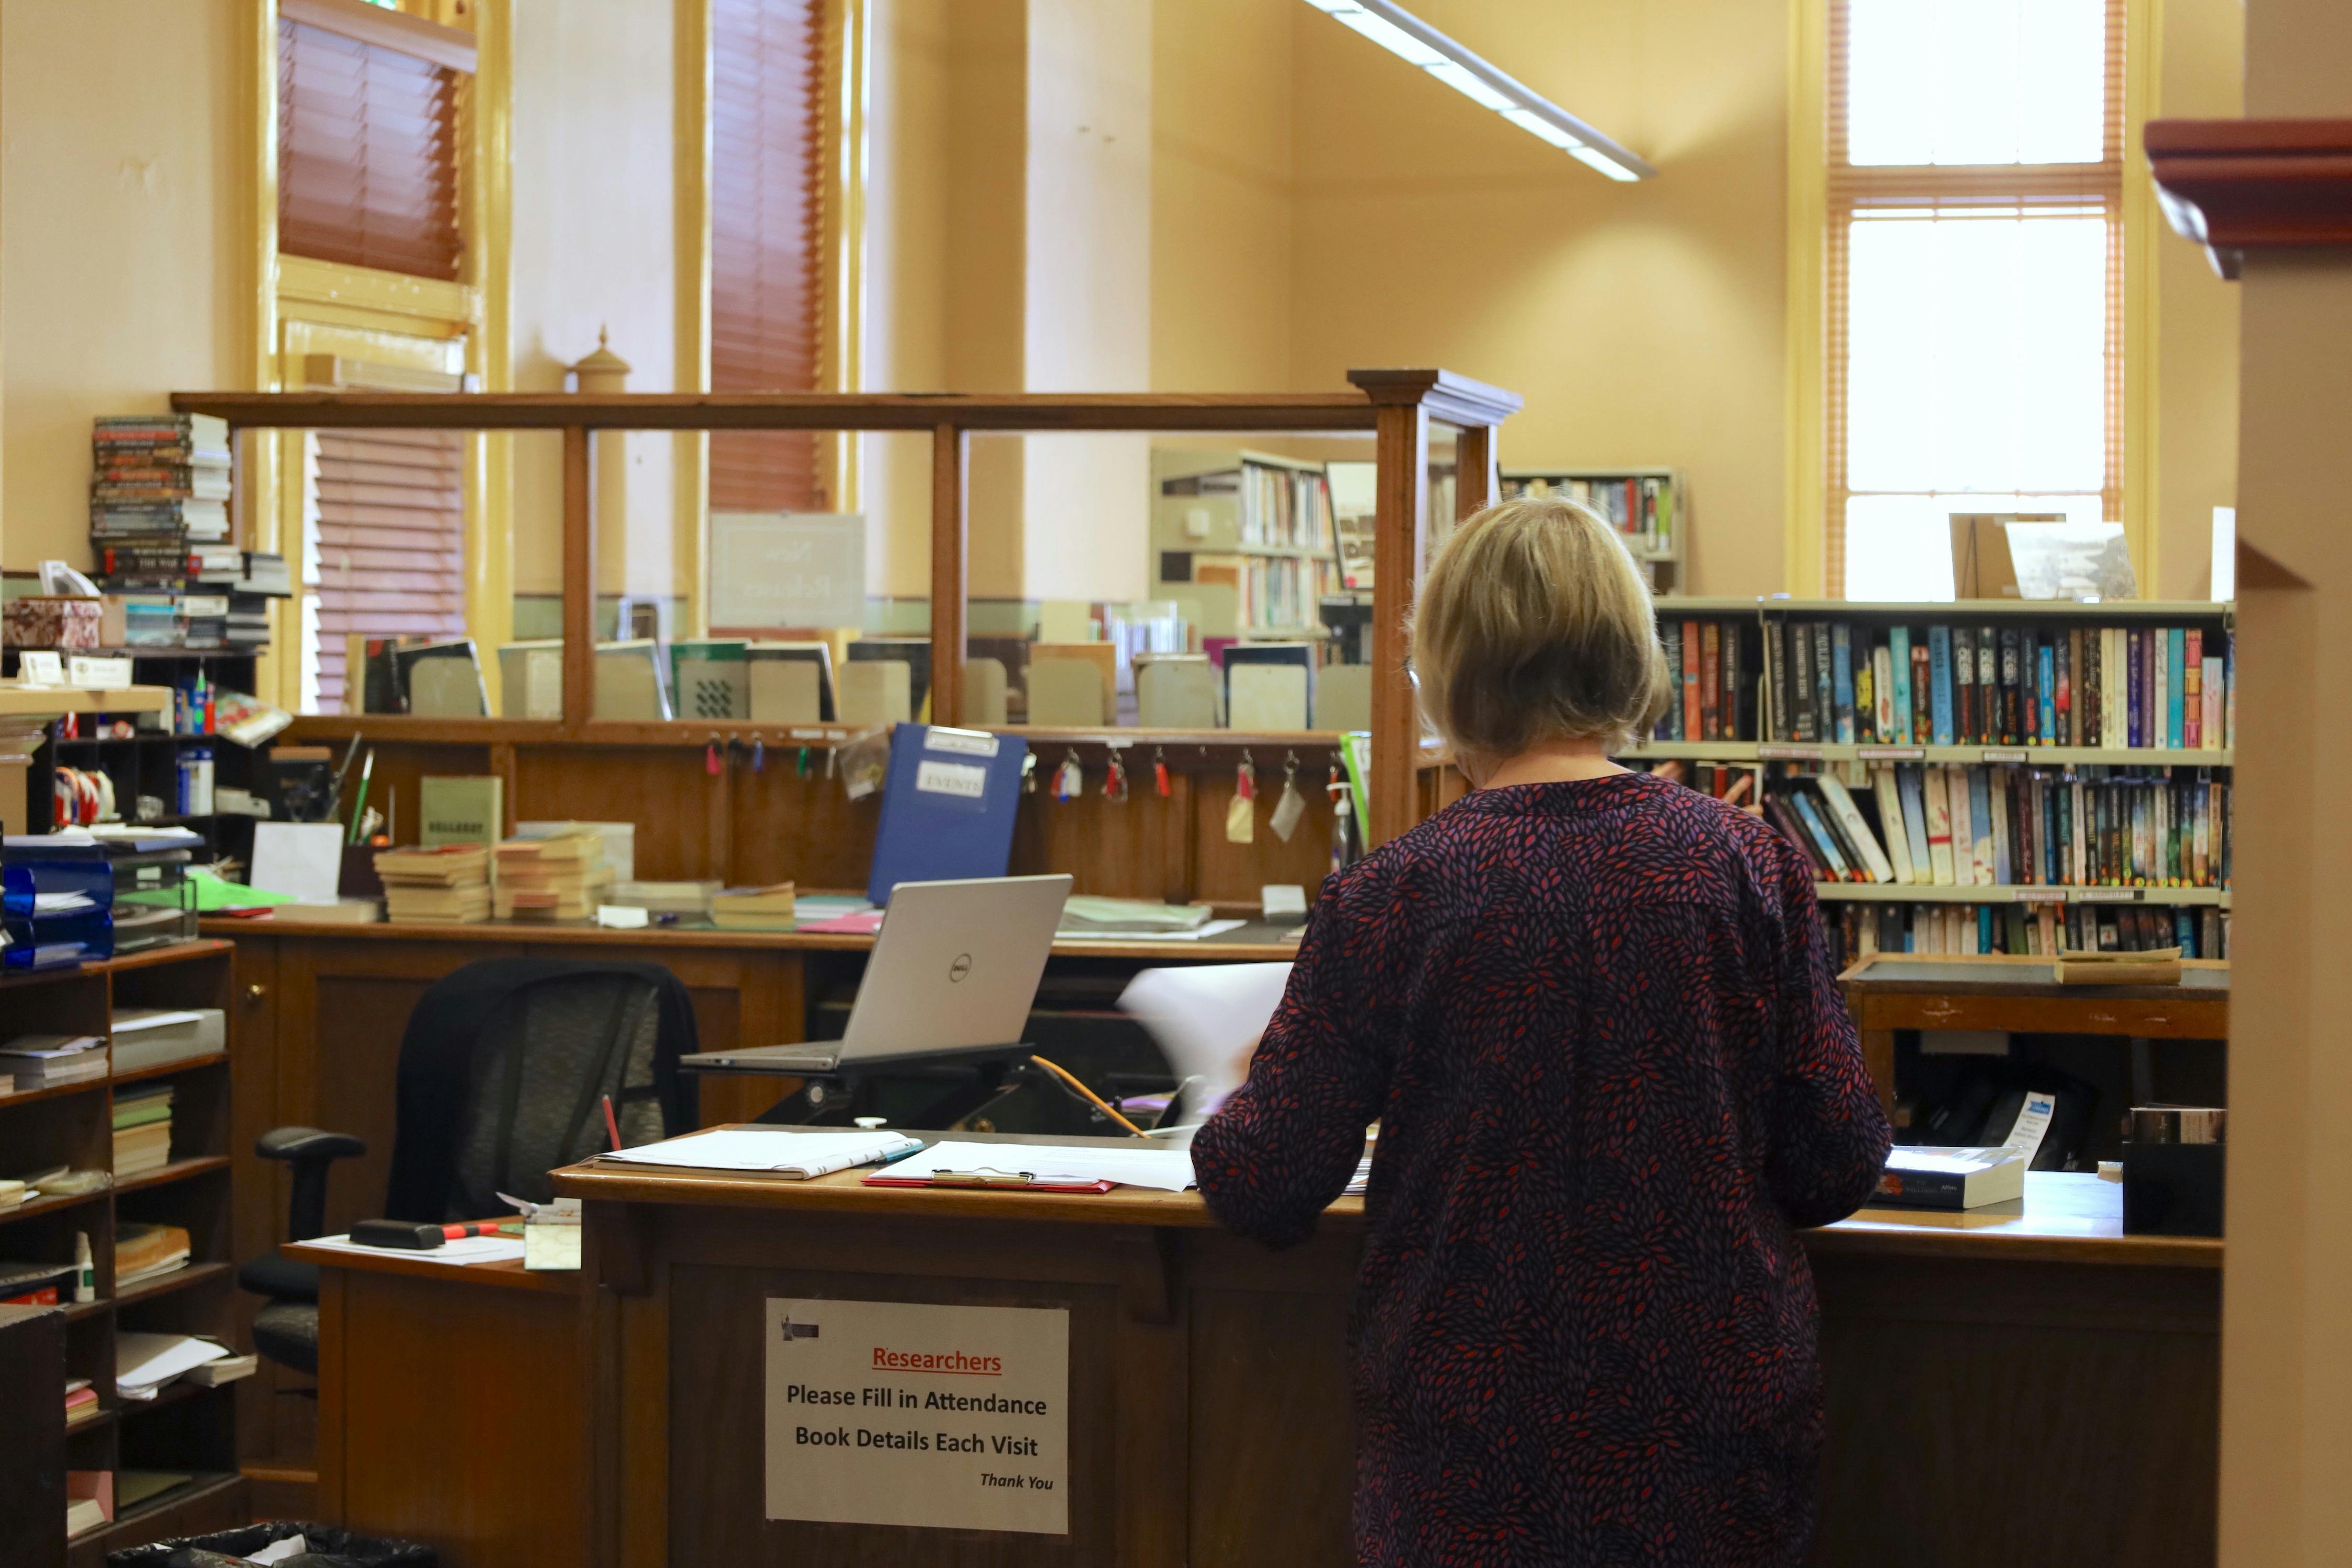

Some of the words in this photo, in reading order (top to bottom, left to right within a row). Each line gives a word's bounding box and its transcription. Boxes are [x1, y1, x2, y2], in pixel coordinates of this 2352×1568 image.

[873, 1347, 1001, 1371] Researchers
[787, 1385, 855, 1406] Please
[862, 1388, 891, 1407] Fill
[899, 1389, 918, 1408] in
[925, 1391, 1046, 1415] Attendance
[796, 1426, 850, 1447] Book
[857, 1429, 929, 1450] Details
[936, 1433, 984, 1453] Each
[991, 1435, 1037, 1456] Visit
[981, 1474, 1023, 1489] Thank
[1028, 1476, 1053, 1490] You
